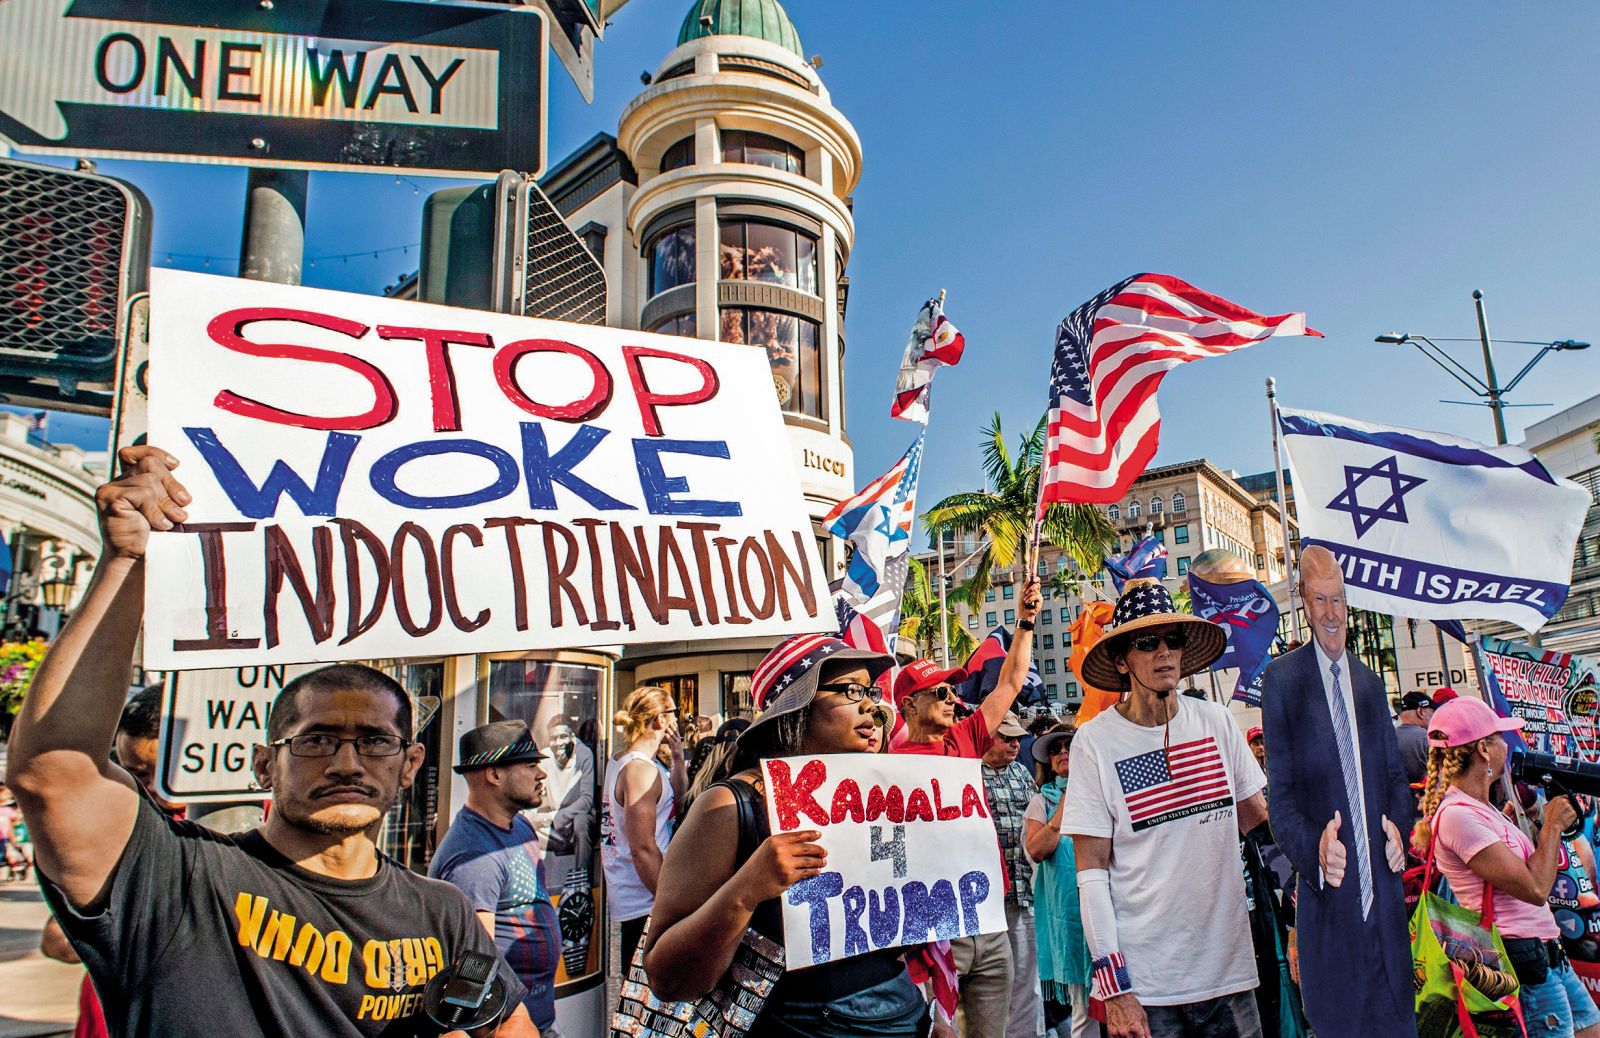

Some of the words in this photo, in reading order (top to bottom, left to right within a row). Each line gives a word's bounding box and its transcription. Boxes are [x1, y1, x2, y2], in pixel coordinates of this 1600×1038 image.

[95, 33, 262, 103] ONE
[307, 47, 466, 114] WAY
[207, 307, 720, 437] STOP
[182, 421, 742, 518] WOKE
[151, 516, 819, 652] INDOCTRINATION
[1414, 570, 1549, 607] ISRAEL
[237, 666, 286, 689] ON
[1533, 661, 1571, 687] HILLS
[1512, 707, 1525, 718] GET
[1534, 682, 1569, 710] RALLY
[182, 742, 256, 774] SIG
[766, 759, 988, 831] KAMALA
[1147, 815, 1168, 826] UNITED
[1168, 809, 1190, 819] STATES
[1199, 801, 1224, 812] AMERICA
[1214, 809, 1233, 821] 1776
[870, 825, 907, 878] 4
[788, 870, 990, 965] TRUMP
[1549, 896, 1579, 908] Group
[234, 892, 352, 985] DOWN
[362, 936, 444, 988] GRID
[357, 993, 424, 1021] POWER
